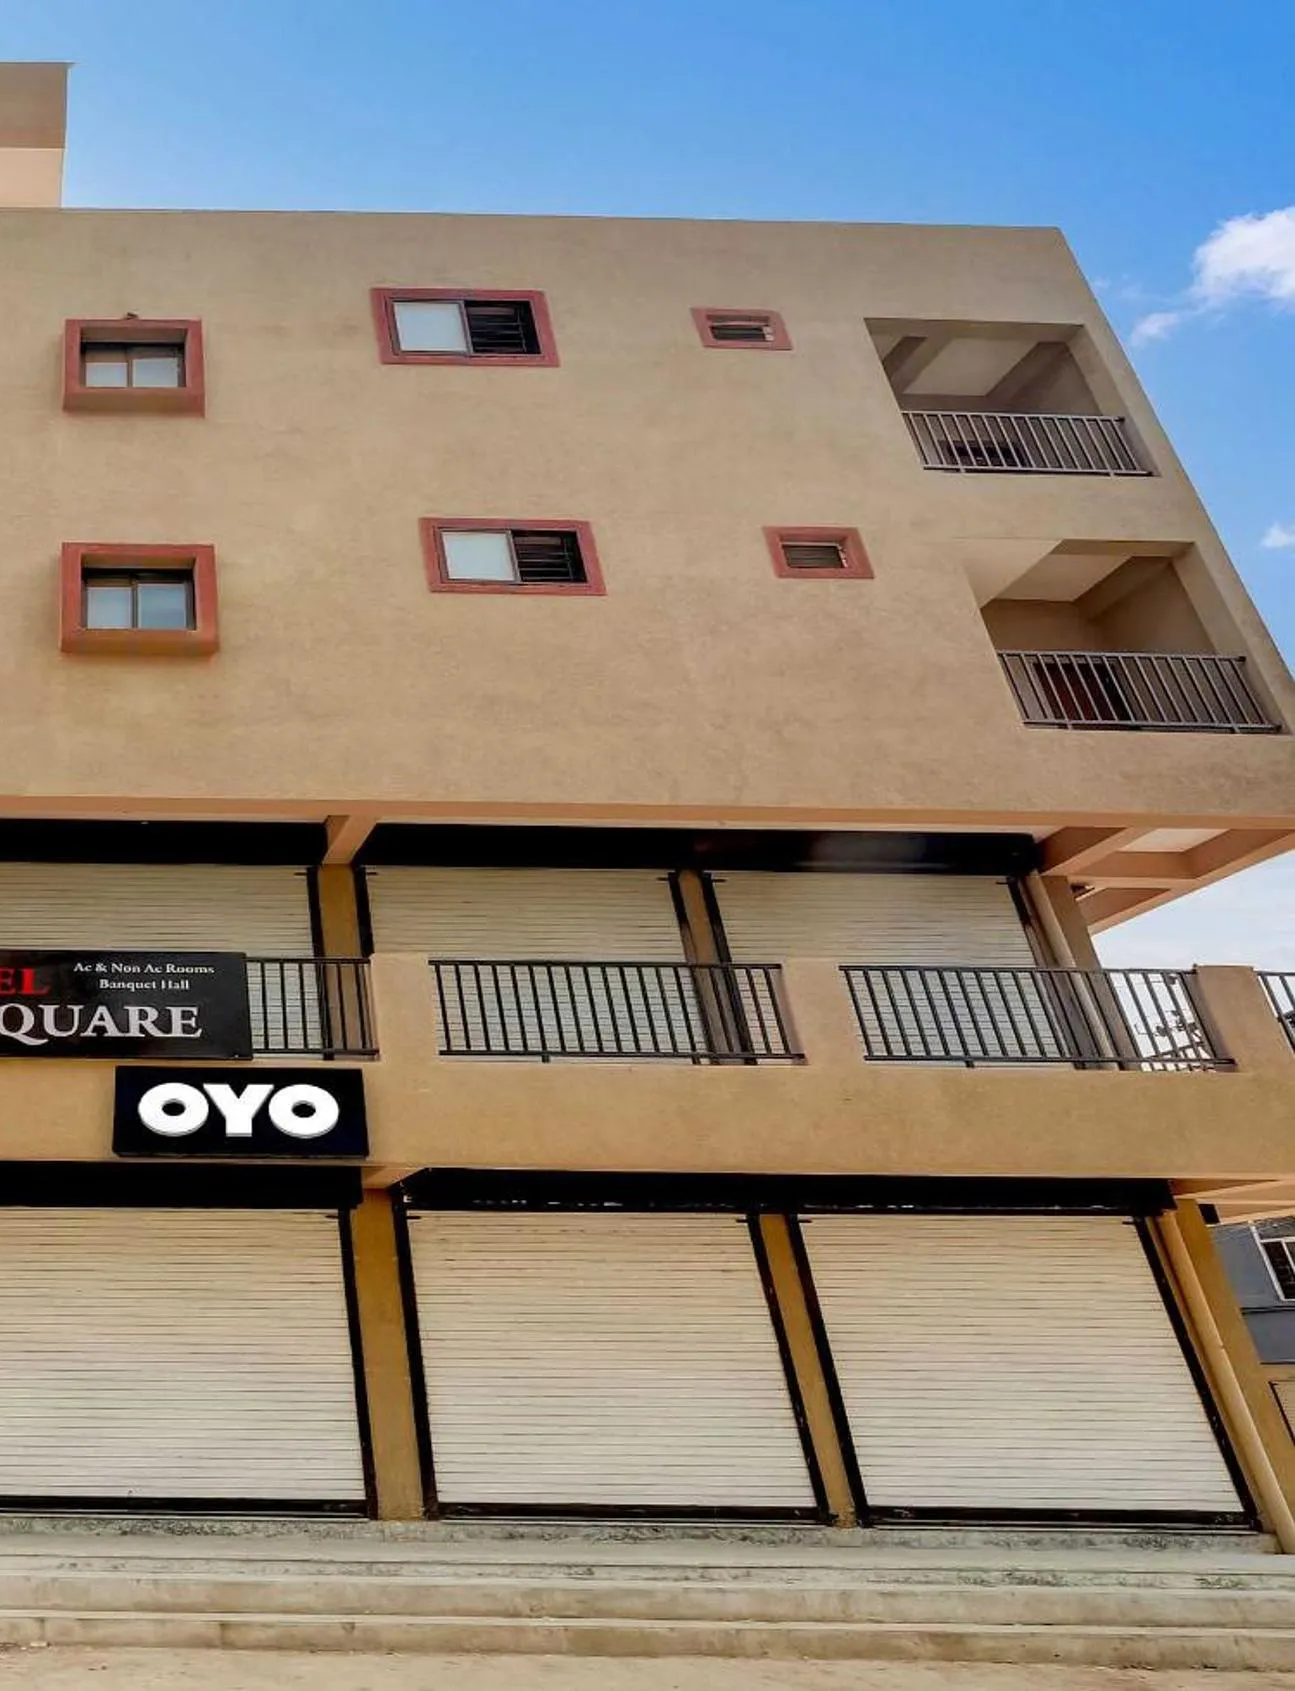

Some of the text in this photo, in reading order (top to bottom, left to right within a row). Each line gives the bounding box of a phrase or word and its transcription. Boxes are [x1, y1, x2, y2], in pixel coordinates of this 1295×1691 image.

[73, 962, 215, 974] Ac & Non Ac Rooms
[99, 979, 190, 992] Banquet Hall
[137, 1082, 340, 1139] OYO
